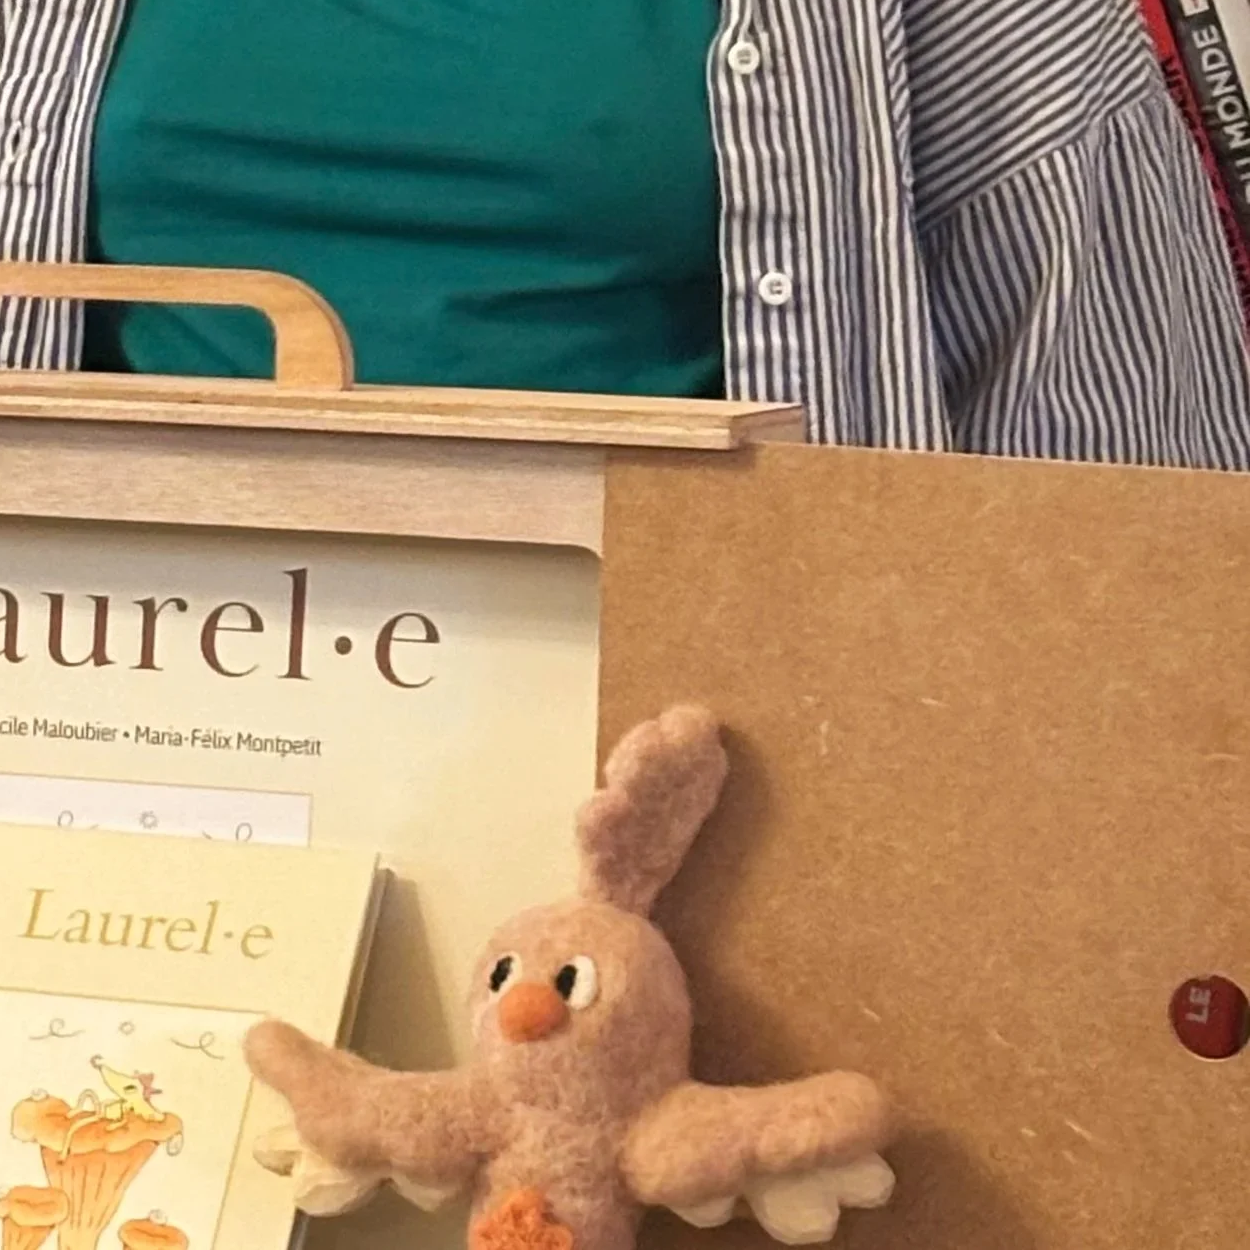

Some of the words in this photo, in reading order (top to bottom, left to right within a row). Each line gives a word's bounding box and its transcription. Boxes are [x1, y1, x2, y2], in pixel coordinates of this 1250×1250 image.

[1192, 24, 1250, 151] MONDE
[32, 718, 118, 742] Maloubier
[134, 724, 233, 752] Maria-Félix
[236, 731, 323, 759] Montpetit
